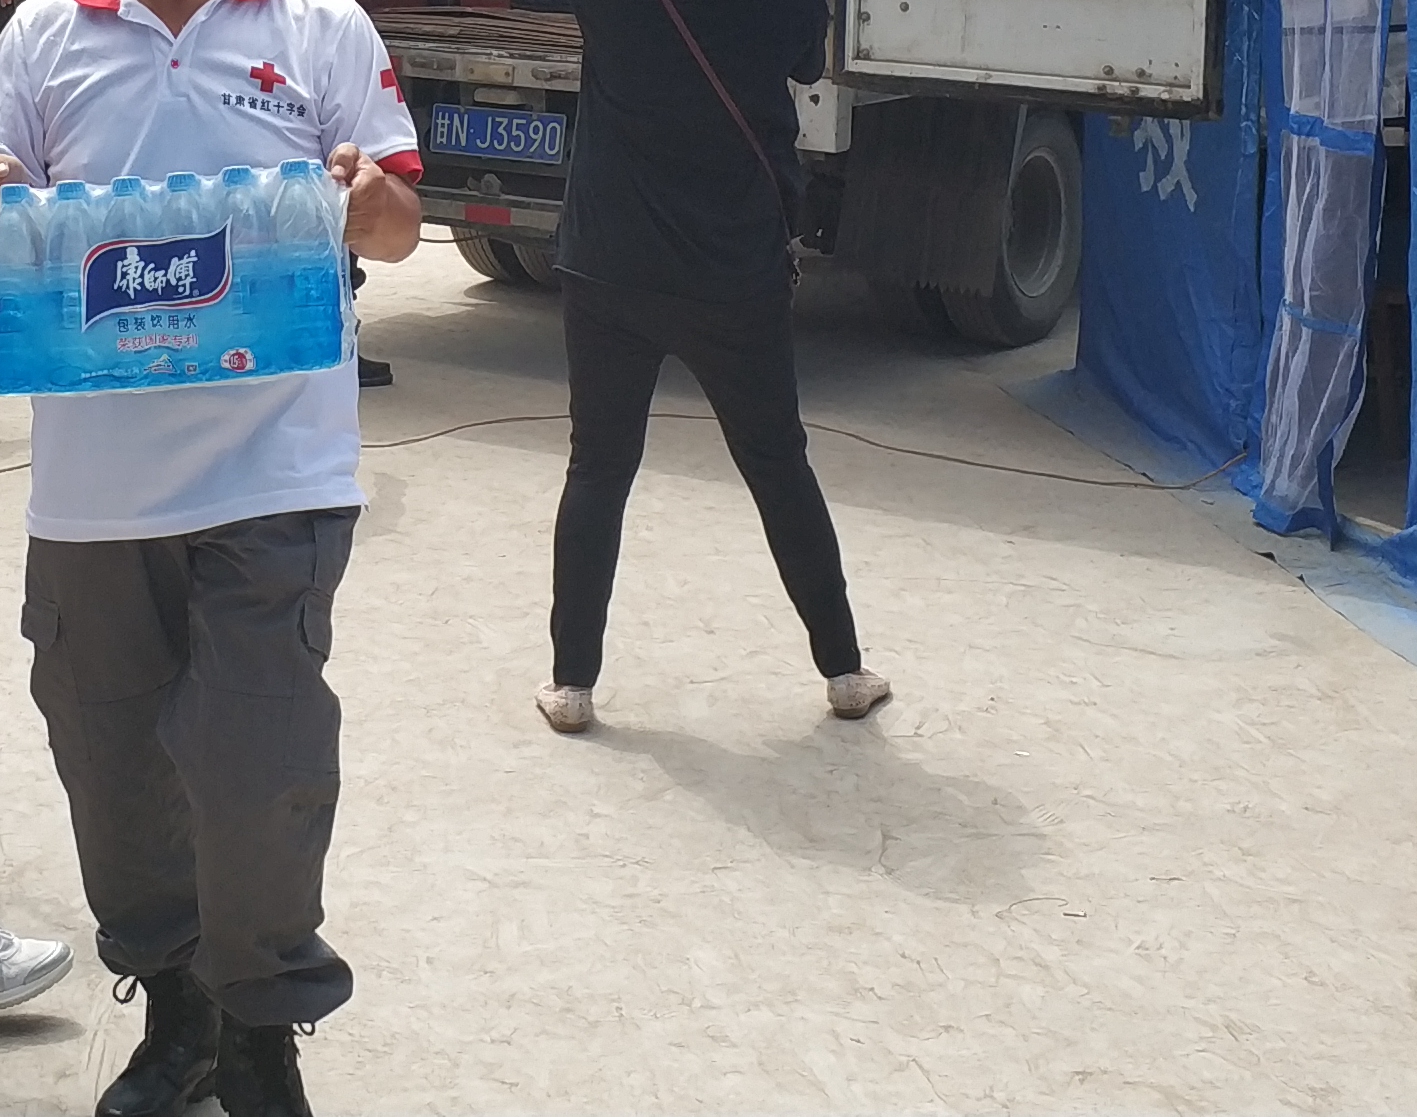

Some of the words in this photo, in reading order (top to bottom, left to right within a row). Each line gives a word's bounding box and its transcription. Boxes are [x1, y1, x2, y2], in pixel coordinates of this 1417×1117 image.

[221, 92, 307, 117] 甘肃省红十字会
[117, 313, 197, 333] 包装饮用水
